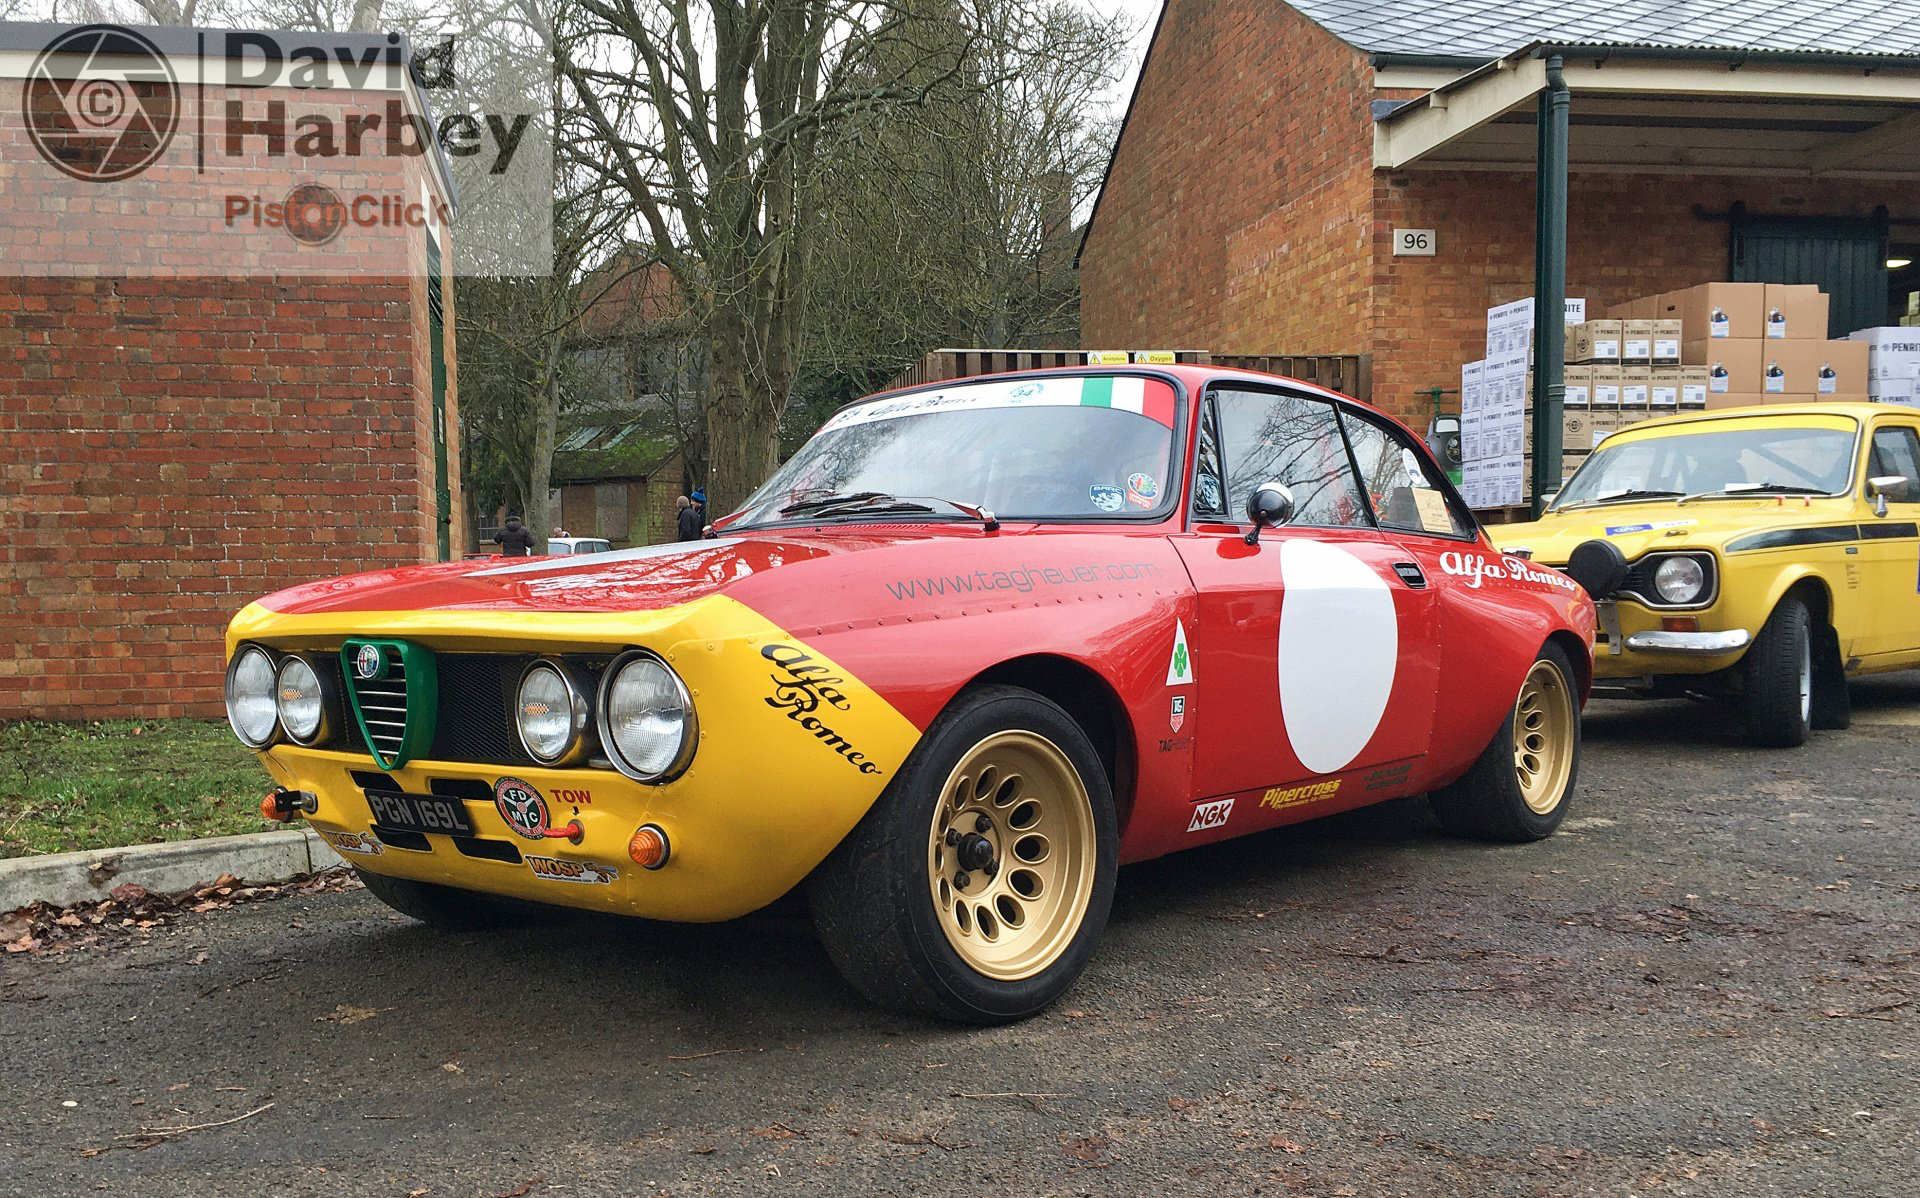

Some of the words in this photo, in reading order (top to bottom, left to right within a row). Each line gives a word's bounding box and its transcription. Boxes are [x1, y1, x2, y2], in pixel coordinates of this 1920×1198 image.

[1404, 233, 1428, 249] 96
[1149, 355, 1173, 363] Oxygen
[1892, 343, 1920, 352] PENRI
[1093, 486, 1122, 494] BARC
[885, 563, 1162, 600] www.tagheuer.com
[1439, 551, 1508, 589] Alfa
[1502, 556, 1577, 591] Romeo
[761, 644, 851, 711] Alfa
[763, 674, 883, 774] Romeo
[549, 789, 592, 804] TOW
[1259, 779, 1342, 808] Pipercross
[368, 795, 416, 825] PGN
[414, 800, 469, 831] 169L
[1190, 802, 1231, 829] NGK
[326, 831, 363, 849] WOSP
[525, 855, 585, 877] WOSP
